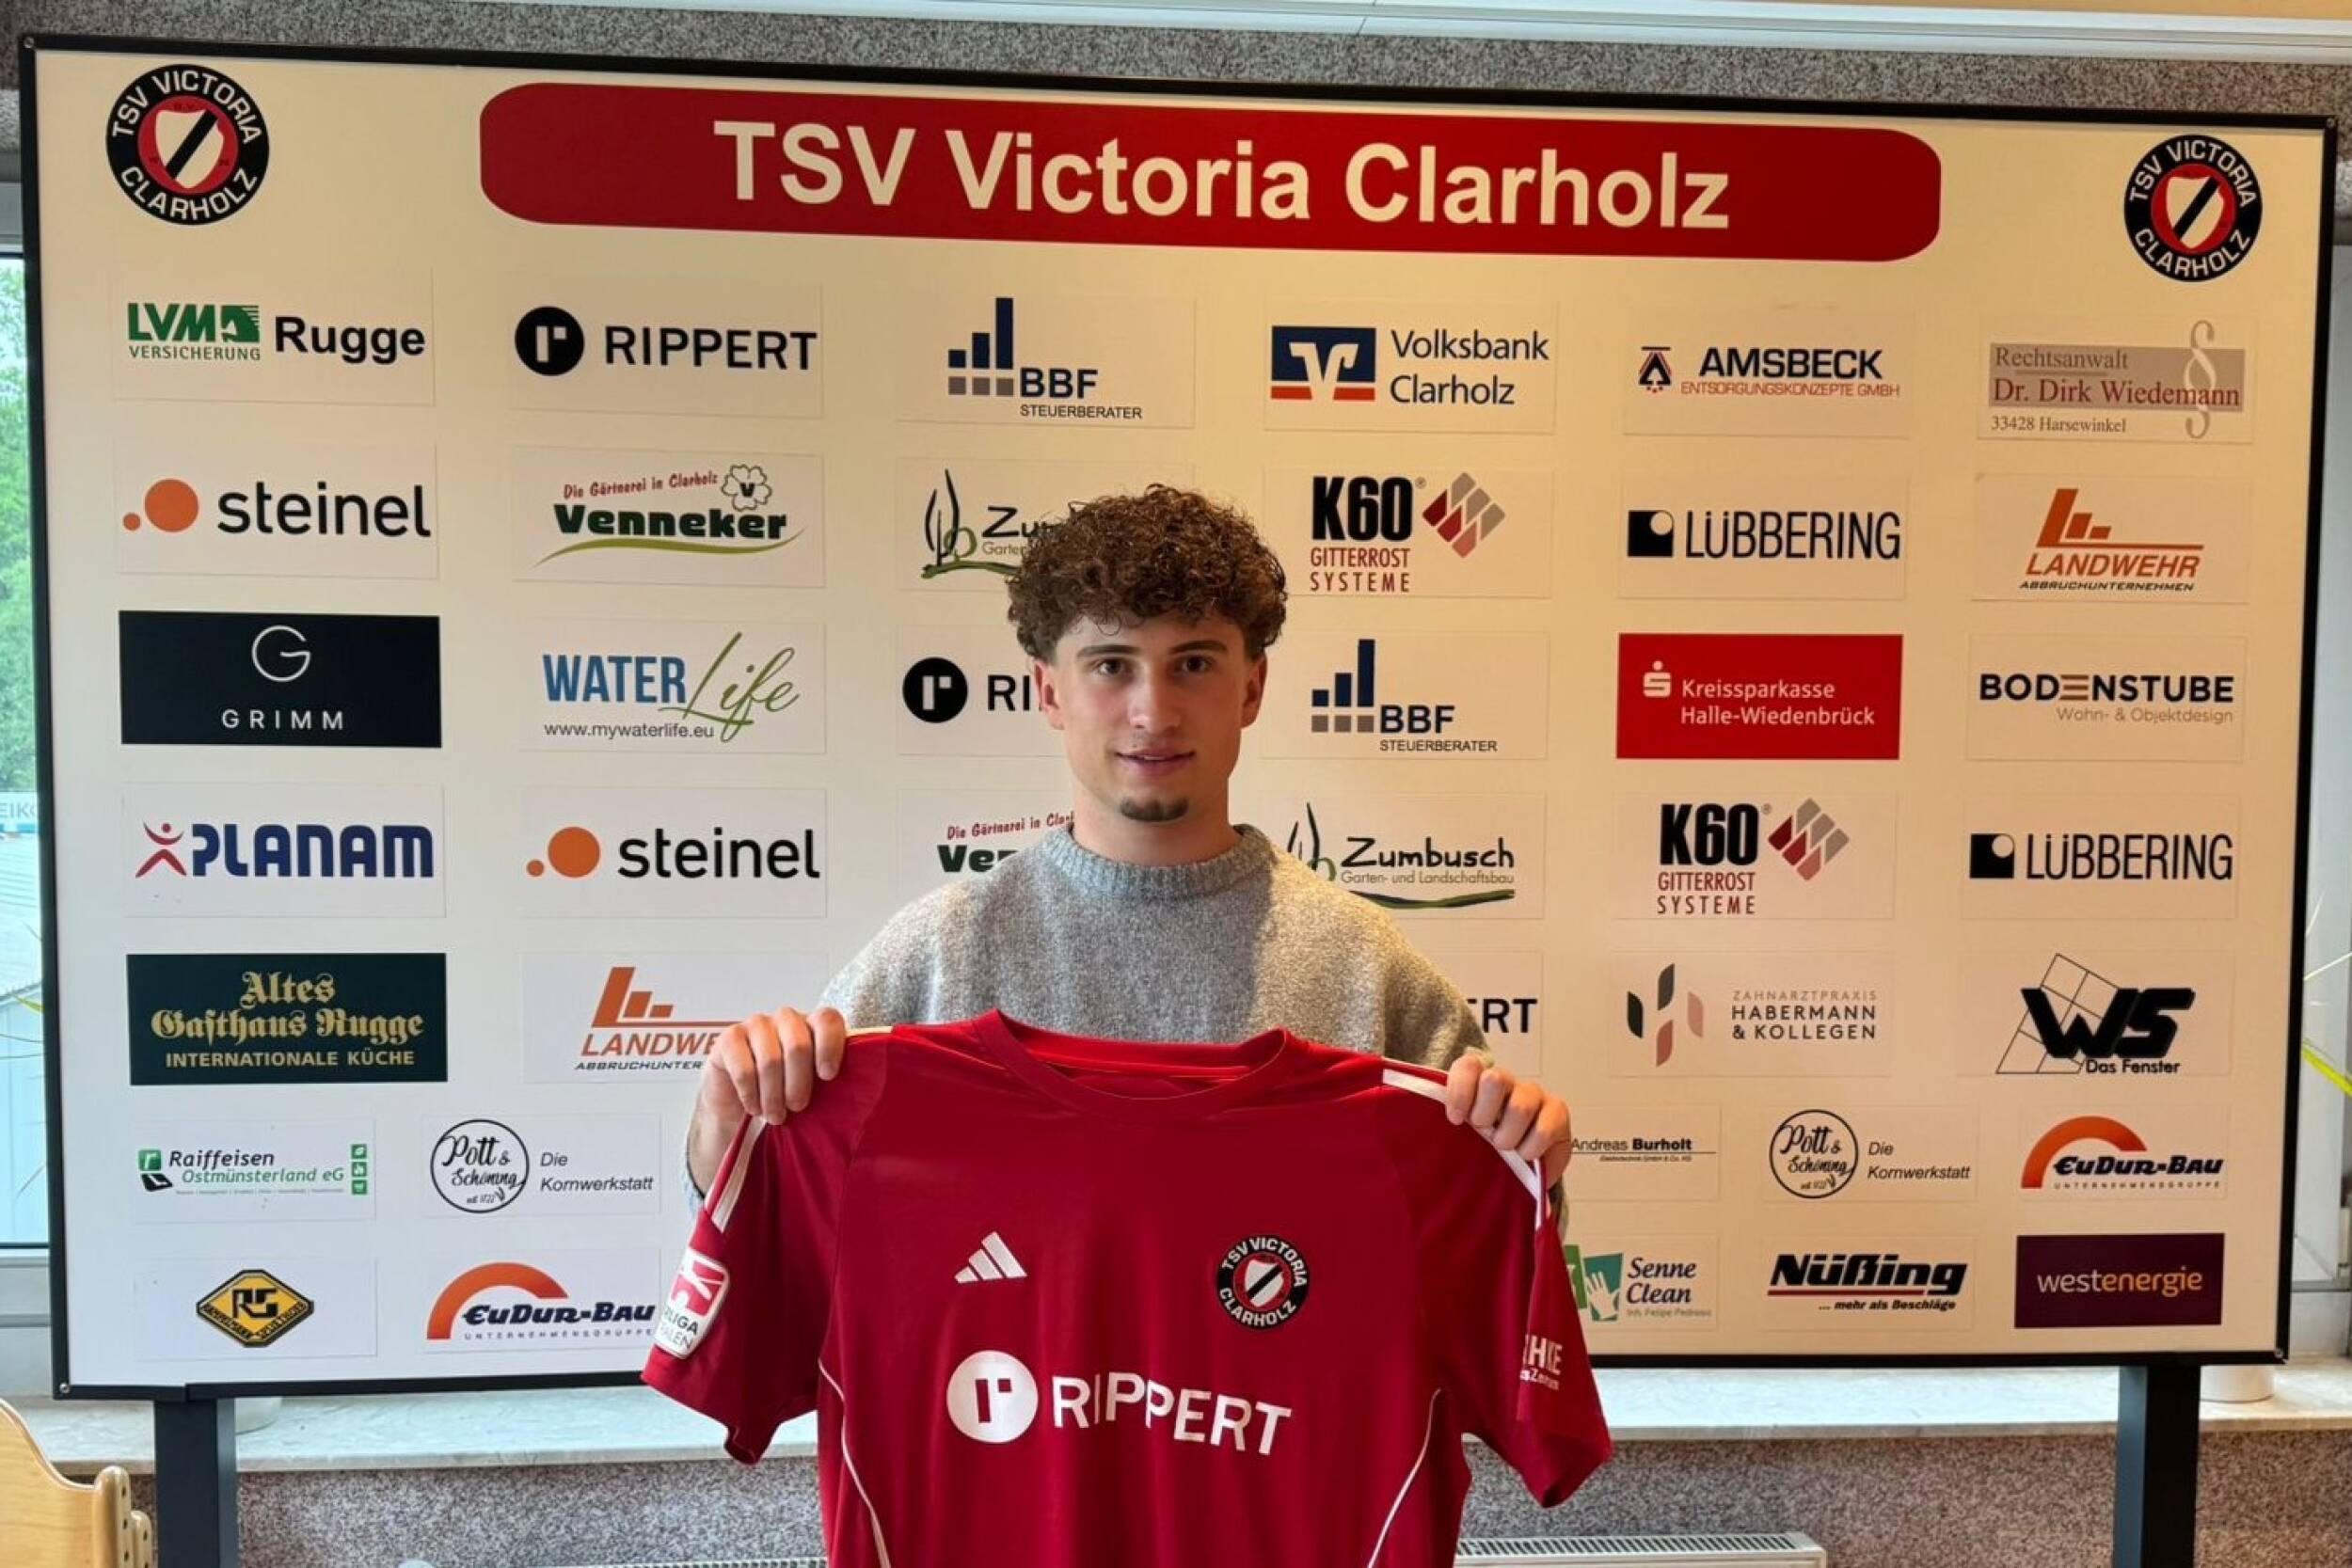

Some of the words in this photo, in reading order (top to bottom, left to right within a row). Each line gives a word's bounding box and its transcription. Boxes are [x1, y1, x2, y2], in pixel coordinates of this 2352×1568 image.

[112, 87, 149, 137] TSV
[151, 71, 262, 144] VICTORIA
[714, 121, 915, 208] TSV
[946, 130, 1311, 222] Victoria
[1344, 142, 1730, 231] Clarholz
[2129, 154, 2163, 202] TSV
[2166, 140, 2257, 207] VICTORIA
[120, 166, 258, 220] CLARHOLZ
[2135, 230, 2250, 277] CLARHOLZ
[127, 303, 216, 342] LVM
[129, 345, 261, 360] VERSICHERUNG
[275, 316, 425, 365] Rugge
[605, 325, 818, 371] RIPPERT
[1391, 329, 1549, 360] Volksbank
[1698, 347, 1883, 380] AMSBECK
[1994, 347, 2129, 370] Rechtsanwalt
[1020, 367, 1098, 399] BBF
[1391, 373, 1516, 404] Clarholz
[1680, 382, 1853, 396] ENTSORGUNGSKONZEPTE
[1857, 383, 1899, 397] GMBH
[1994, 378, 2028, 402] Dr.
[2039, 379, 2091, 403] Dirk
[2100, 380, 2240, 406] Wiedemann
[1020, 404, 1142, 420] STEUERBERATER
[1991, 416, 2035, 431] 33428
[2039, 417, 2126, 433] Harsewinkel
[564, 483, 583, 499] Die
[590, 478, 646, 497] Gärtnerei
[217, 482, 431, 537] steinel
[554, 504, 787, 539] Venneker
[1686, 511, 1900, 560] LÜBBERING
[1311, 547, 1411, 568] GITTERROST
[2026, 553, 2201, 578] LANDWEHR
[1311, 572, 1410, 593] SYSTEME
[2020, 581, 2194, 592] ABBRUCHUNTERNEHMEN
[542, 654, 687, 704] WATER
[659, 632, 801, 743] Life
[1682, 678, 1836, 702] Kreissparkasse
[1979, 673, 2234, 703] BODENSTUBE
[222, 709, 344, 730] GRIMM
[1380, 705, 1455, 734] BBF
[1680, 705, 1875, 725] Halle-Wiedenbrück
[2057, 707, 2109, 721] Wohn-
[2115, 707, 2126, 721] &
[2130, 707, 2233, 725] Objektdesign
[544, 721, 715, 740] www.mywaterlife.eu
[1379, 739, 1498, 752] STEUERBERATER
[192, 823, 435, 879] PLANAM
[617, 827, 821, 879] steinel
[1341, 837, 1515, 868] Zumbusch
[2026, 833, 2233, 880] LÜBBERING
[1341, 870, 1388, 884] Garten-
[1391, 870, 1415, 884] und
[1419, 870, 1515, 884] Landschaftsbau
[1658, 872, 1756, 892] GITTERROST
[1657, 895, 1756, 914] SYSTEME
[240, 972, 336, 1009] Altes
[1732, 990, 1877, 1002] ZAHNARZTPRAXIS
[1732, 1005, 1876, 1021] HABERMANN
[315, 1007, 424, 1044] Rugge
[1732, 1024, 1745, 1039] &
[1755, 1024, 1876, 1039] KOLLEGEN
[166, 1052, 339, 1069] INTERNATIONALE
[347, 1048, 415, 1067] KÜCHE
[2086, 1059, 2116, 1073] Das
[2122, 1059, 2181, 1074] Fenster
[439, 1134, 501, 1167] Pott
[1571, 1138, 1629, 1151] Andreas
[1632, 1138, 1692, 1150] Burholt
[1780, 1124, 1833, 1154] Pott
[1868, 1142, 1893, 1155] Die
[169, 1149, 276, 1171] Raiffeisen
[540, 1151, 568, 1167] Die
[182, 1168, 316, 1184] Ostmünsterland
[322, 1168, 344, 1182] eG
[540, 1176, 654, 1192] Kornwerkstatt
[1867, 1165, 1971, 1180] Kornwerkstatt
[1222, 1242, 1248, 1269] TSV
[1249, 1237, 1308, 1287] VICTORIA
[1628, 1257, 1697, 1278] Senne
[1770, 1254, 1968, 1295] Nüßing
[2038, 1266, 2203, 1298] westenergie
[1627, 1282, 1692, 1305] Clean
[1835, 1300, 1867, 1310] mehr
[1868, 1299, 1888, 1310] als
[1892, 1299, 1956, 1312] Beschläge
[1219, 1288, 1296, 1326] CLARHOLZ
[1052, 1372, 1292, 1456] RIPPERT
